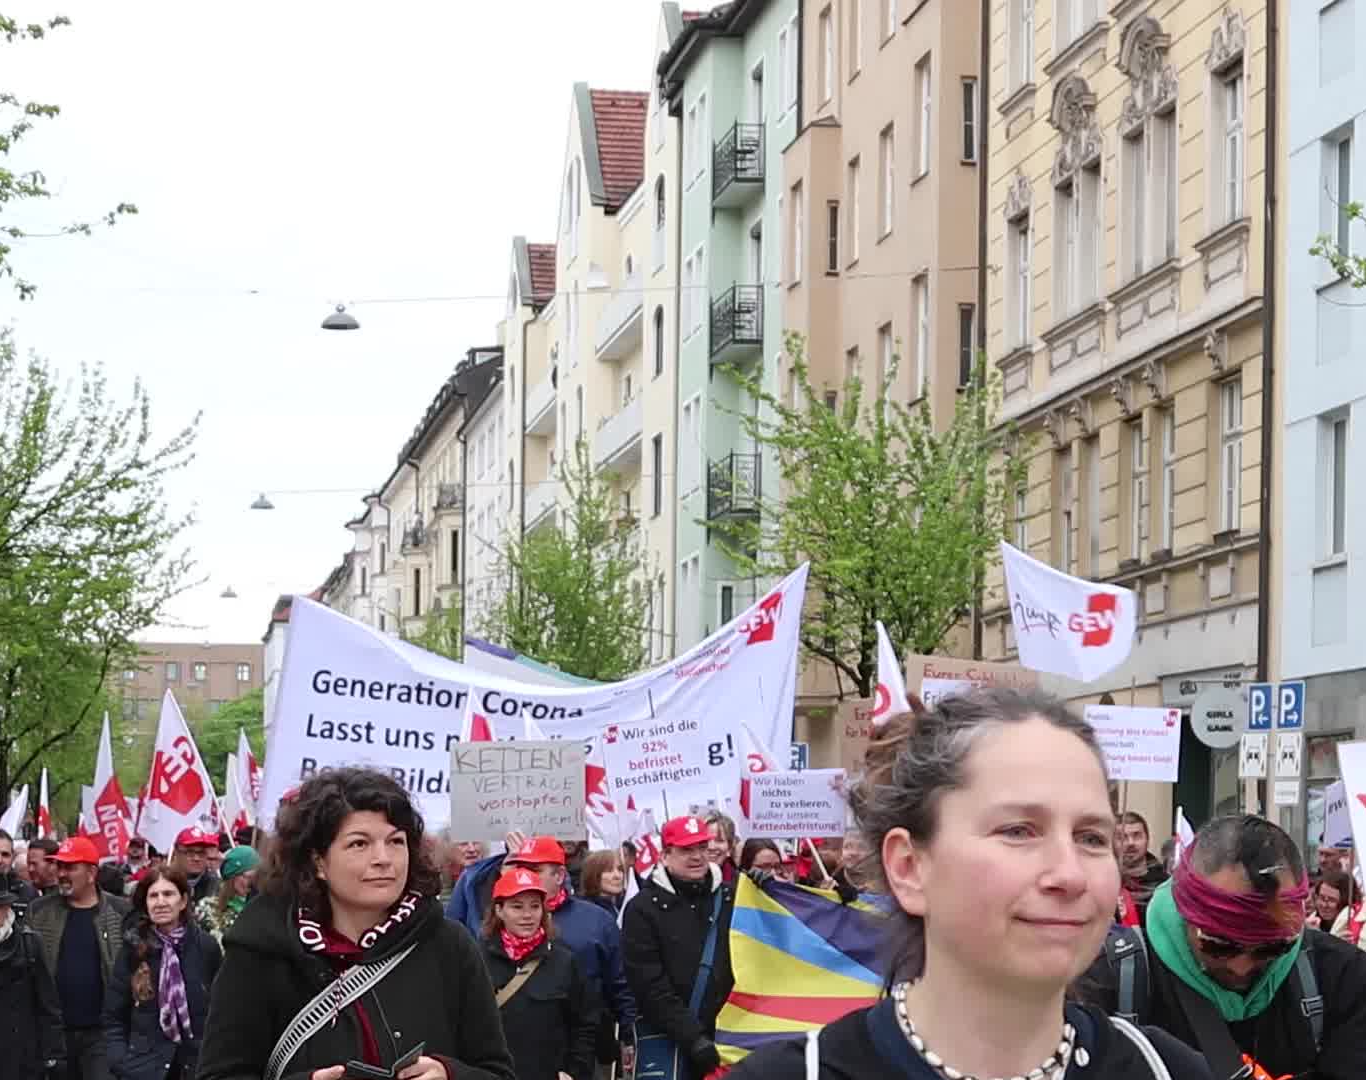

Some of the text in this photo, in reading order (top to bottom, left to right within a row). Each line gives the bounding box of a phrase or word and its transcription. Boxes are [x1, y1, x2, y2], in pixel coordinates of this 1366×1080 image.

[482, 691, 584, 720] Corona
[1251, 689, 1266, 726] P
[1280, 688, 1296, 725] P
[306, 713, 375, 744] Lasst
[385, 727, 436, 751] uns
[622, 719, 698, 740] Wir sind die
[642, 740, 668, 752] 92%
[629, 754, 683, 770] befristet
[392, 766, 450, 793] Bild
[615, 766, 701, 788] Beschäftigten
[753, 777, 805, 786] Wir haben
[761, 789, 792, 798] nichts
